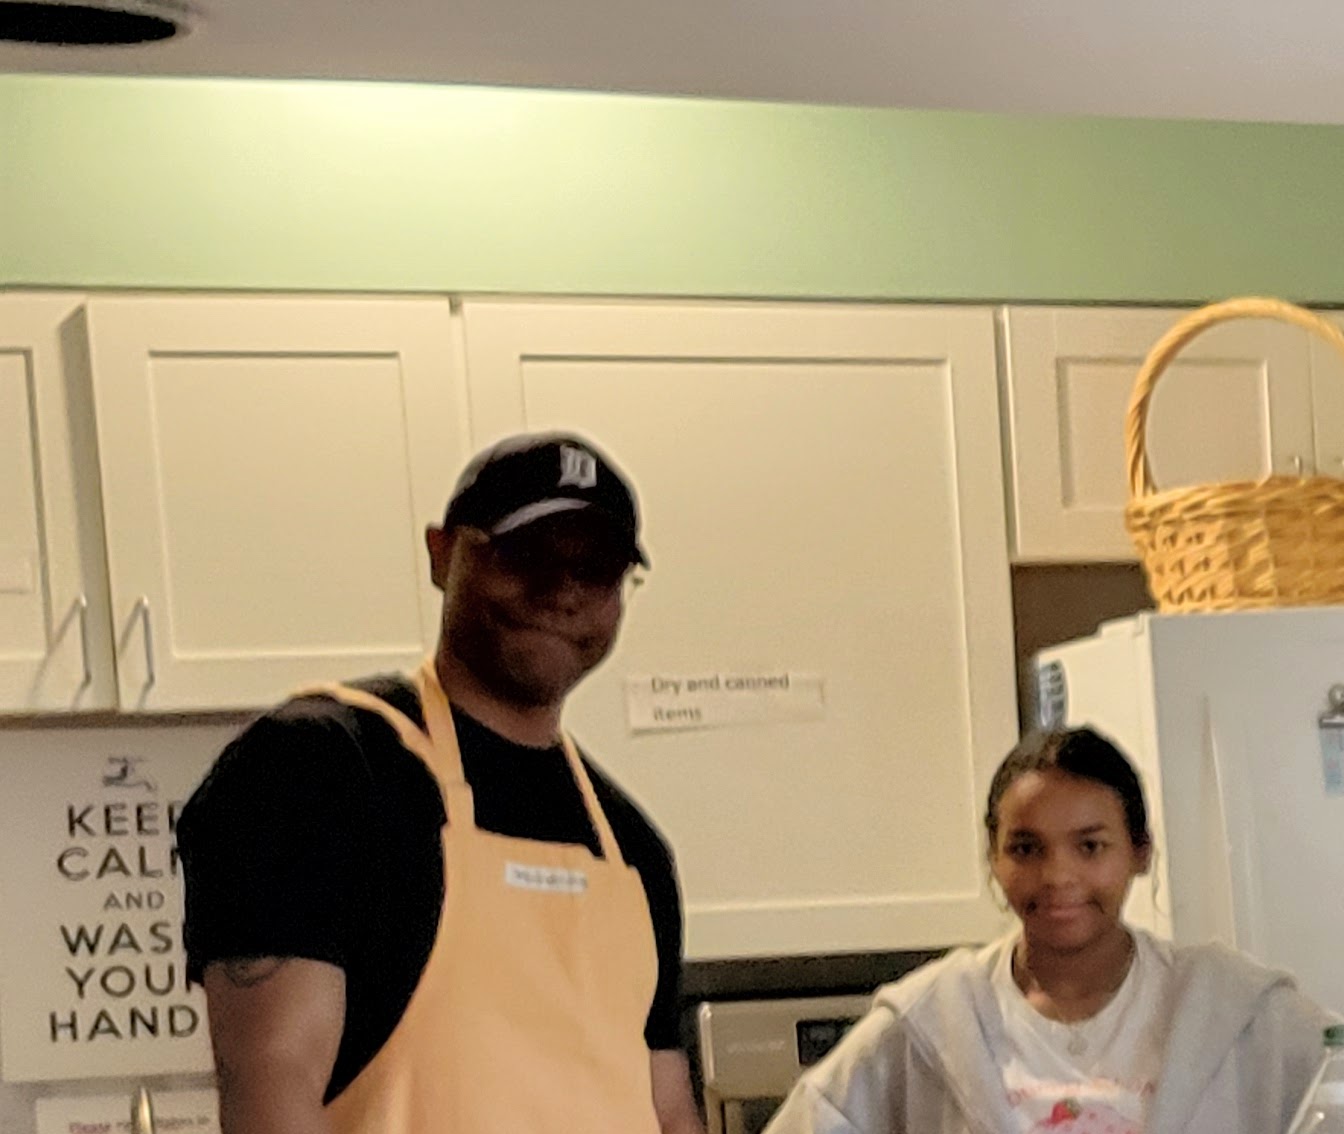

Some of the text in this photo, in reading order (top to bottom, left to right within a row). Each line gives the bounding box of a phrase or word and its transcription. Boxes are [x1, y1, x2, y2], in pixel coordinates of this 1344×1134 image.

[651, 671, 790, 696] Dry and canned
[653, 706, 702, 721] items
[103, 890, 165, 911] AND
[66, 962, 192, 999] YOU
